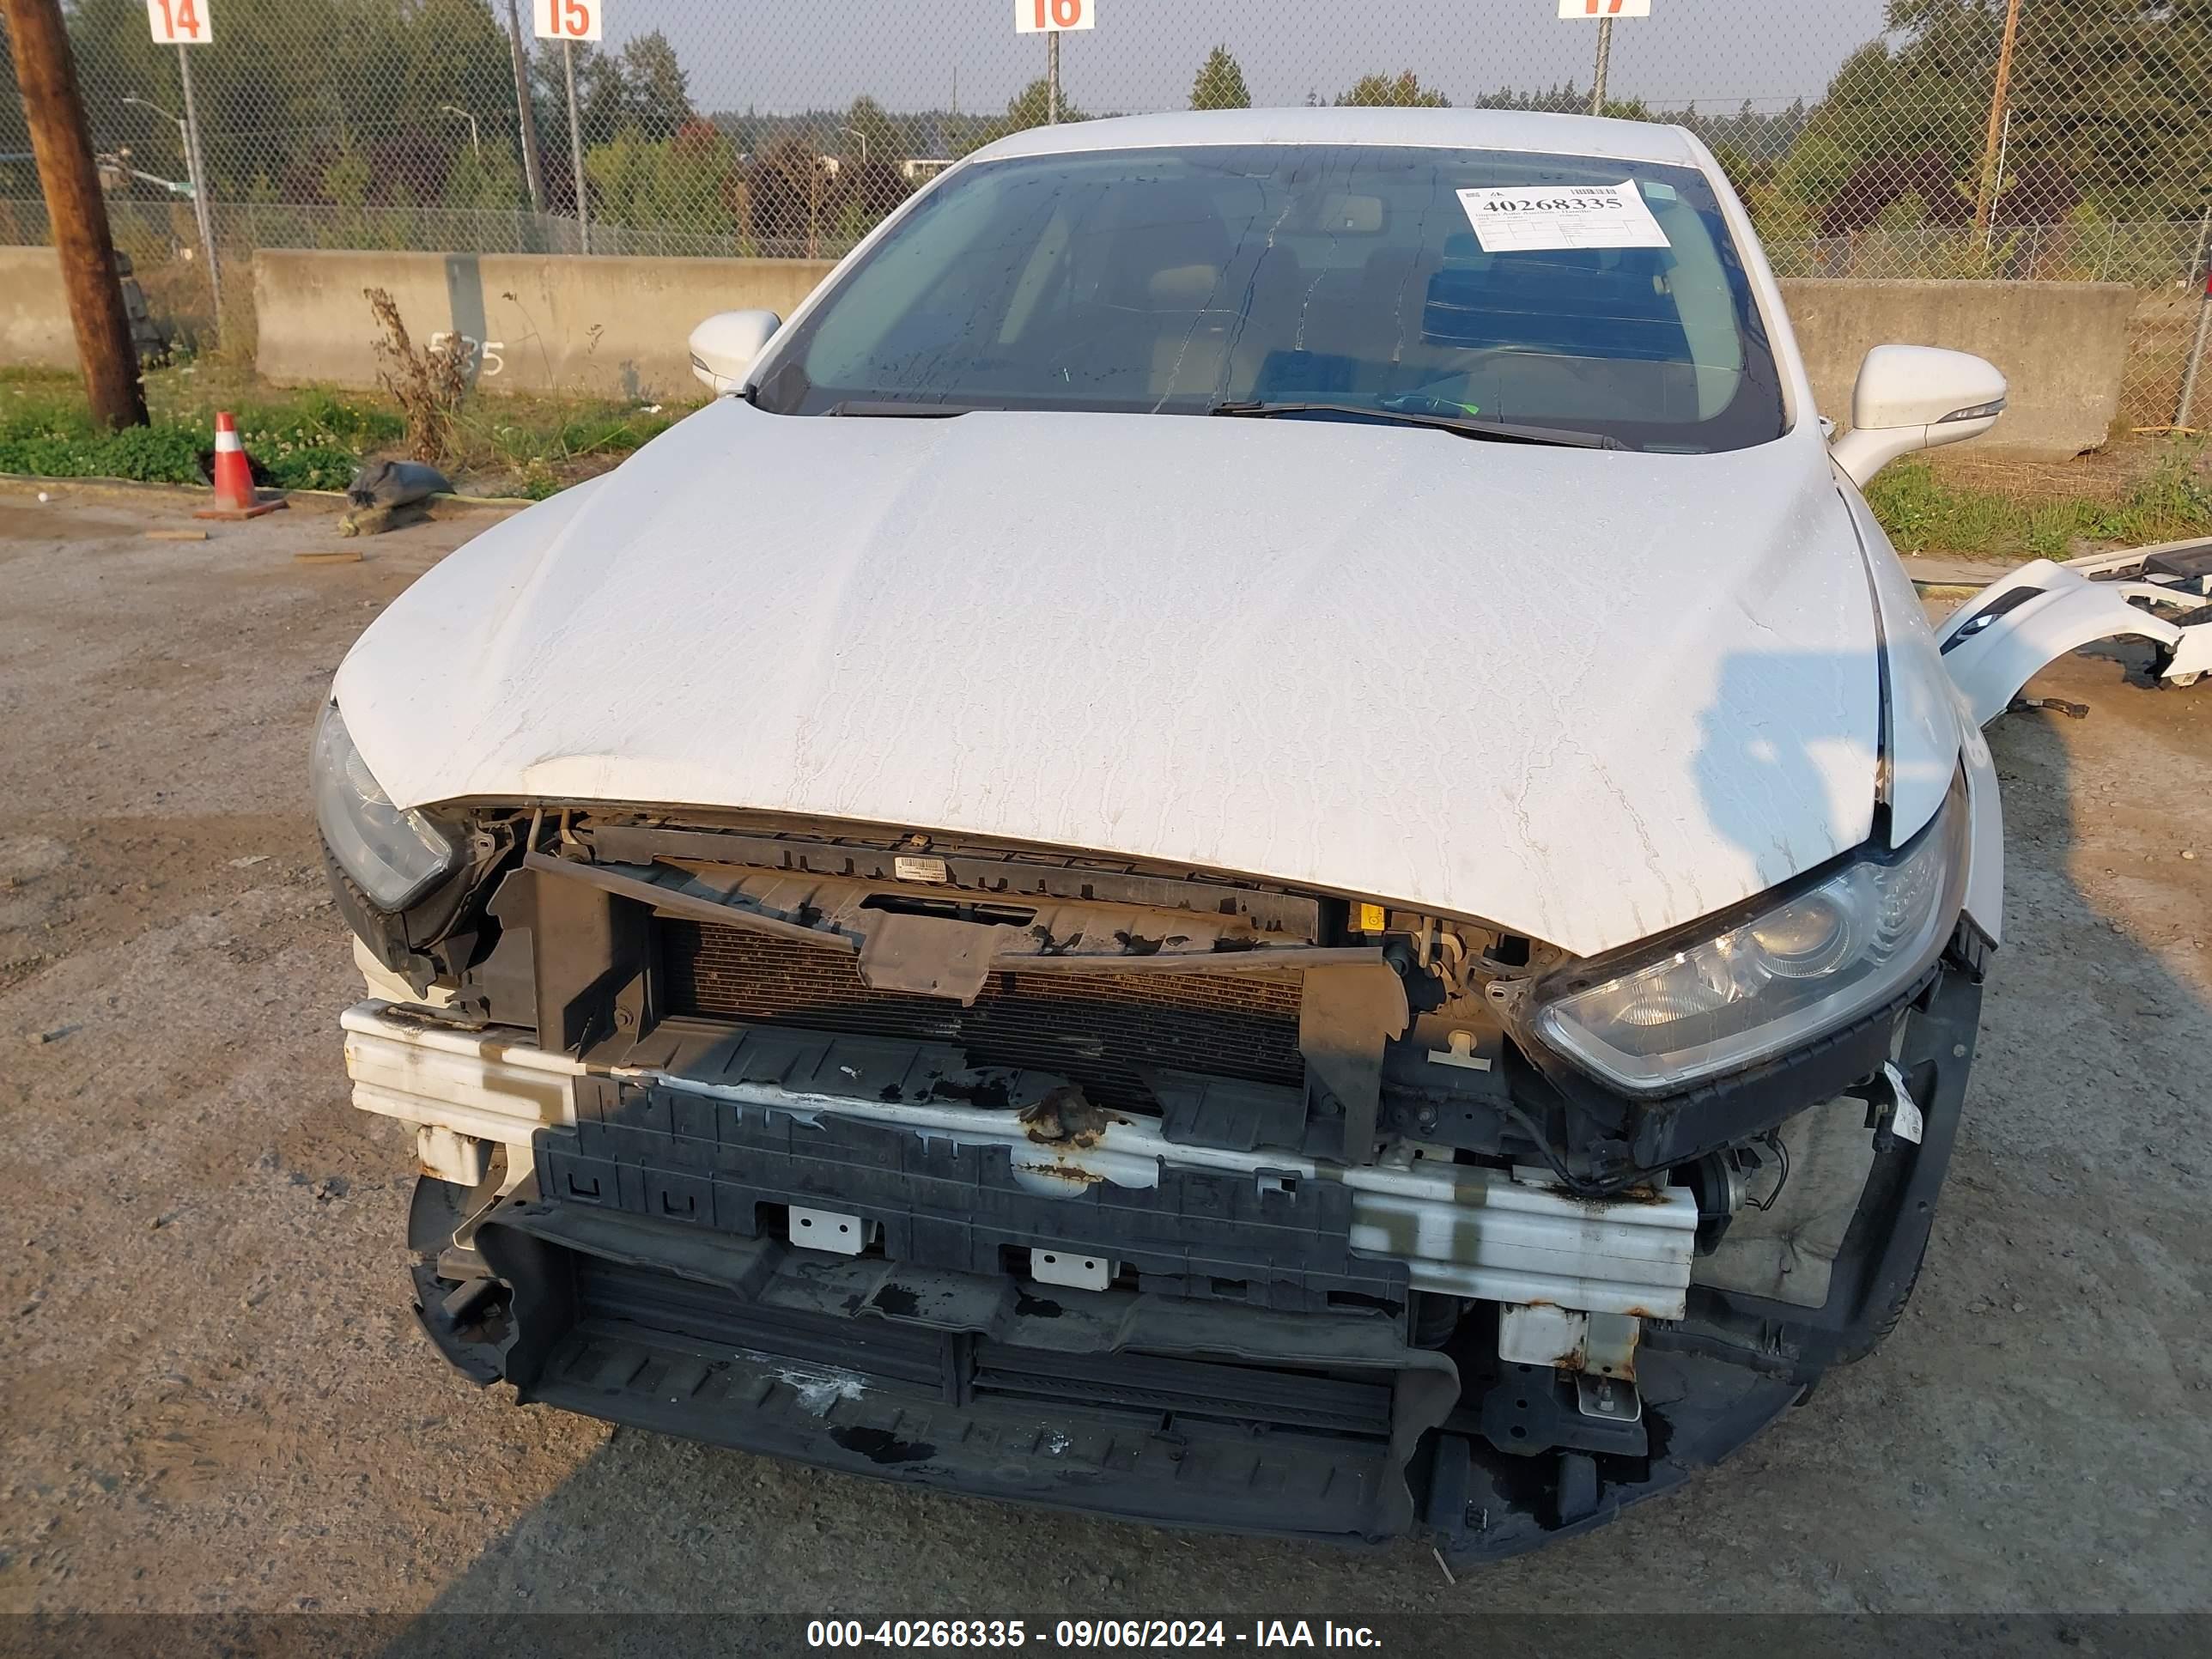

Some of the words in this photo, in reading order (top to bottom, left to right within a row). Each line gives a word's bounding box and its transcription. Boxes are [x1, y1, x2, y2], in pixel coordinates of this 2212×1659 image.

[155, 0, 201, 39] 14
[550, 0, 590, 36] 15
[1483, 198, 1624, 213] 40268335
